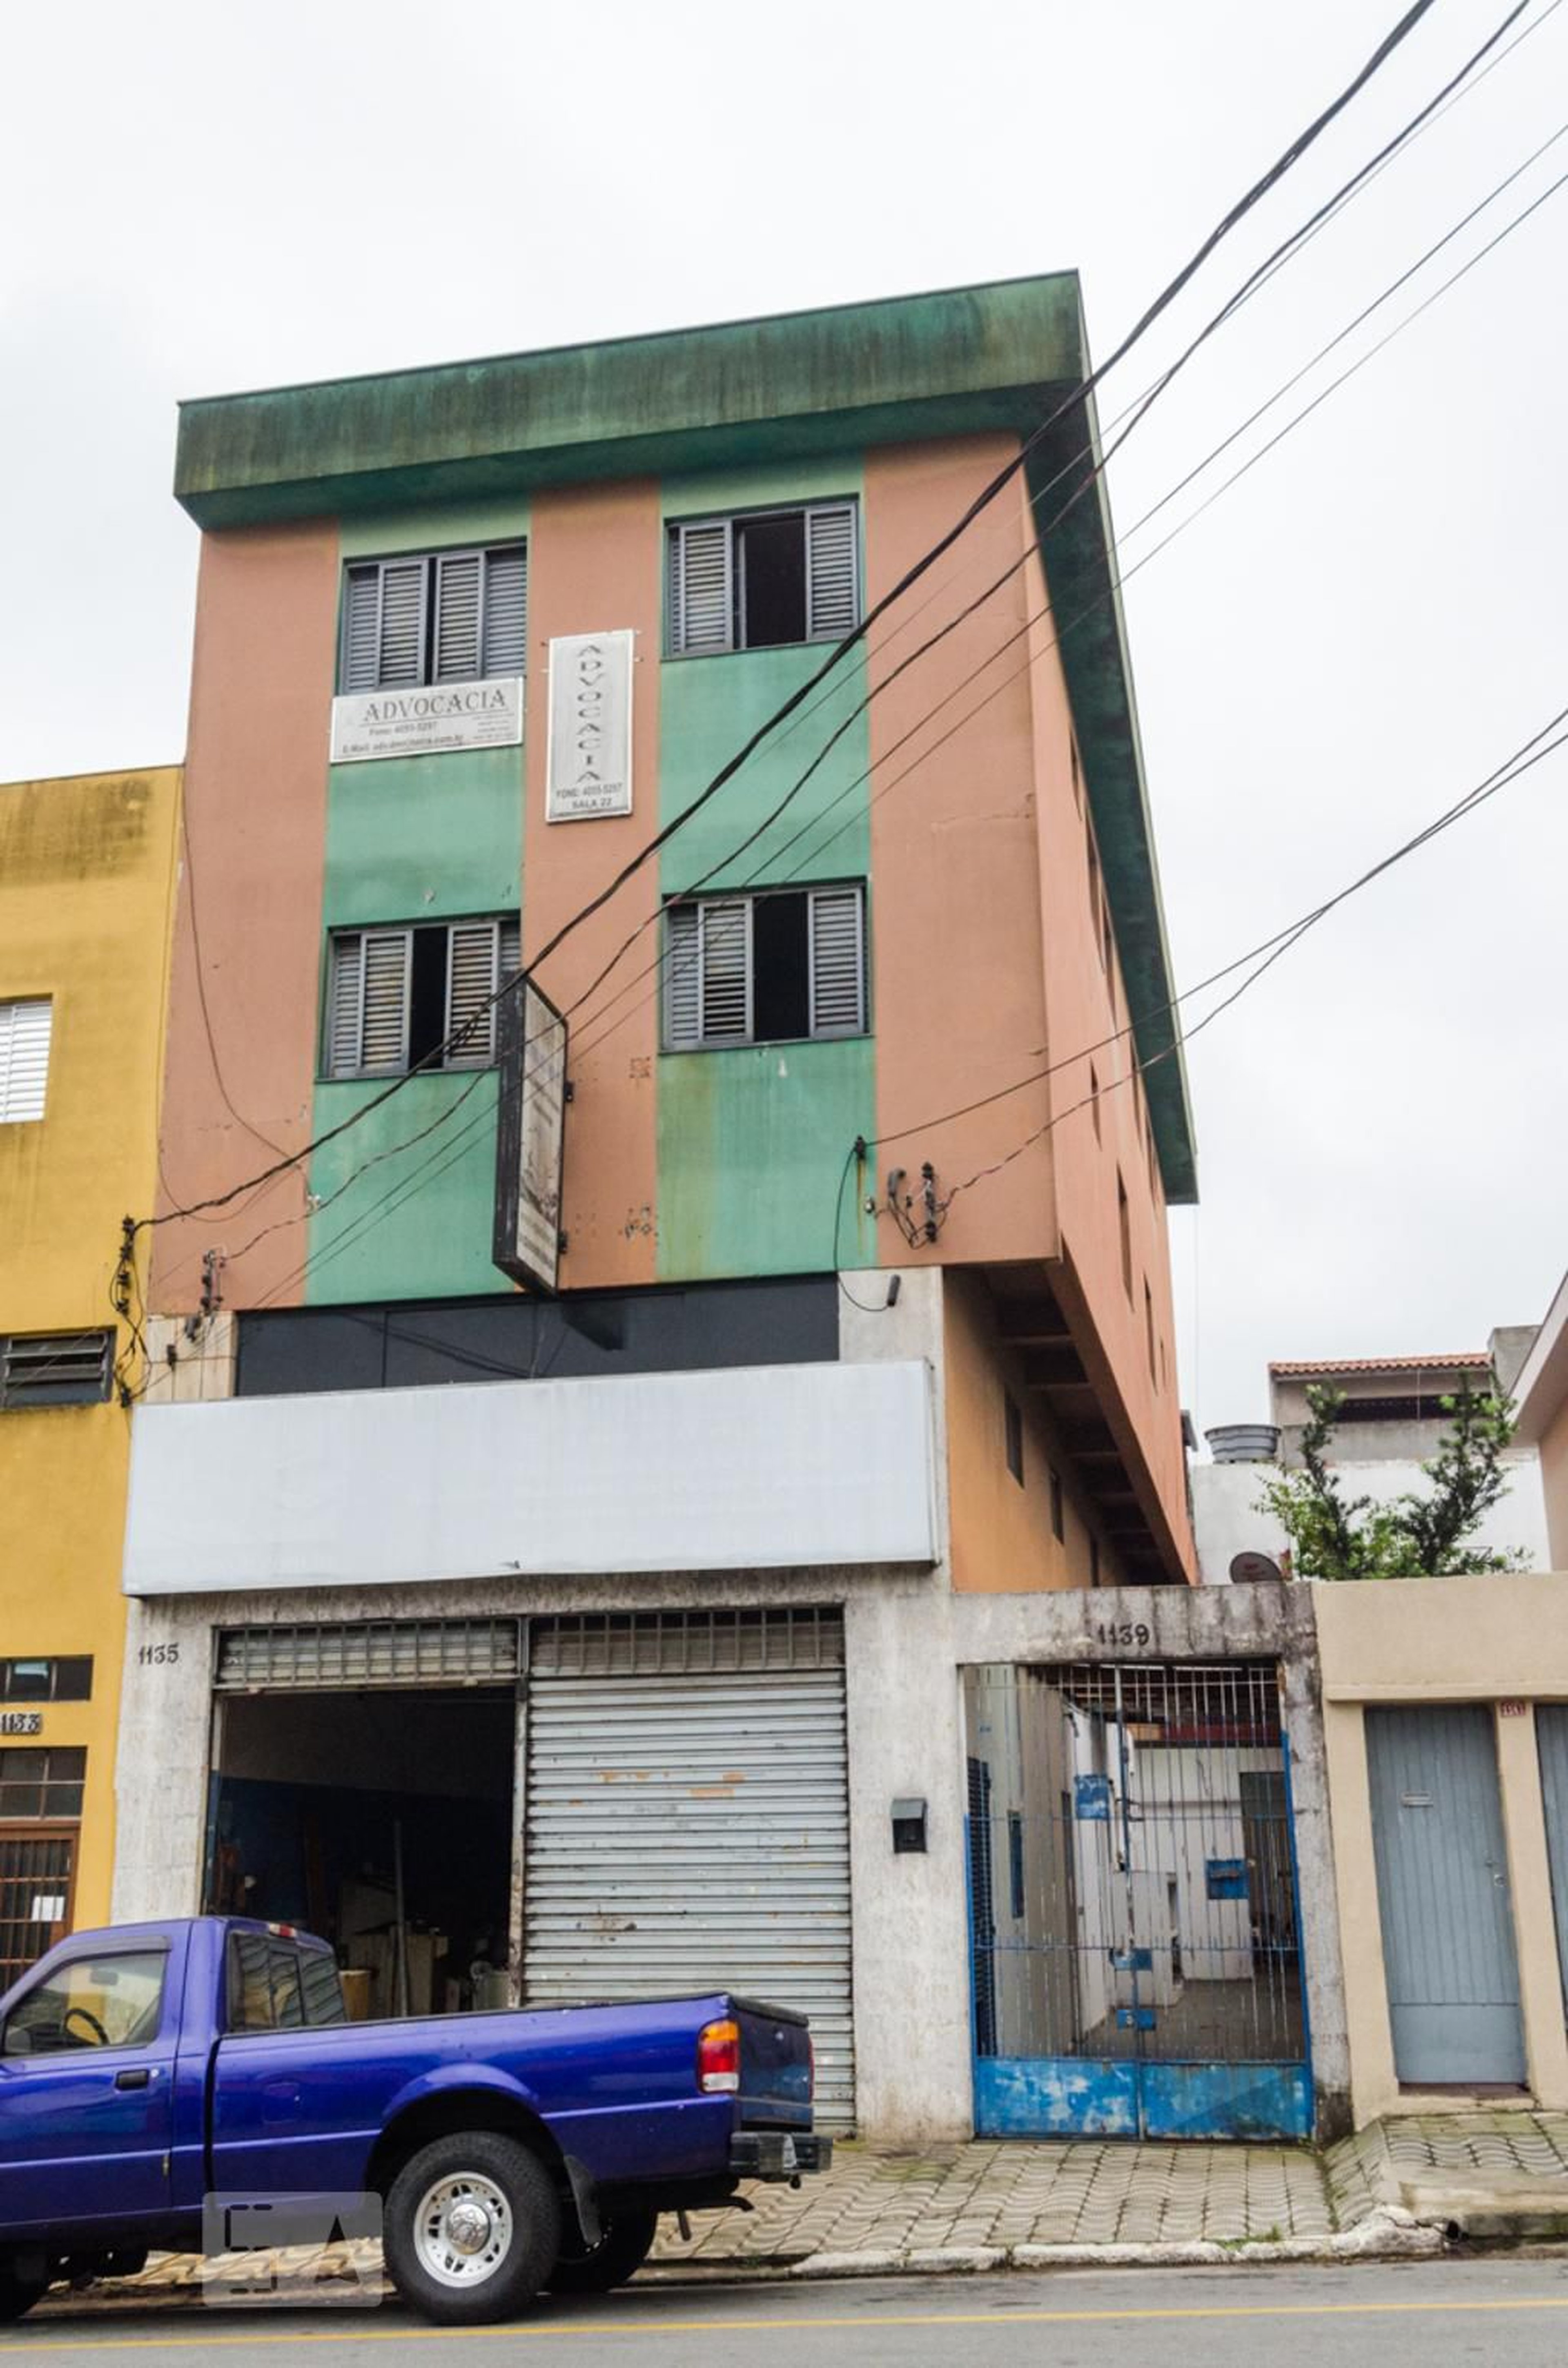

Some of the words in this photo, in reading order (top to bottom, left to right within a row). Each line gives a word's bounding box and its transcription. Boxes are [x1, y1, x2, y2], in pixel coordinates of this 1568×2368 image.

[364, 690, 506, 721] ADVOCACIA
[577, 644, 603, 783] ADVOCACIA
[573, 799, 597, 809] SALA
[601, 798, 612, 807] 22
[1098, 1623, 1149, 1646] 1139
[139, 1642, 179, 1664] 1135
[2, 1713, 40, 1731] 1133
